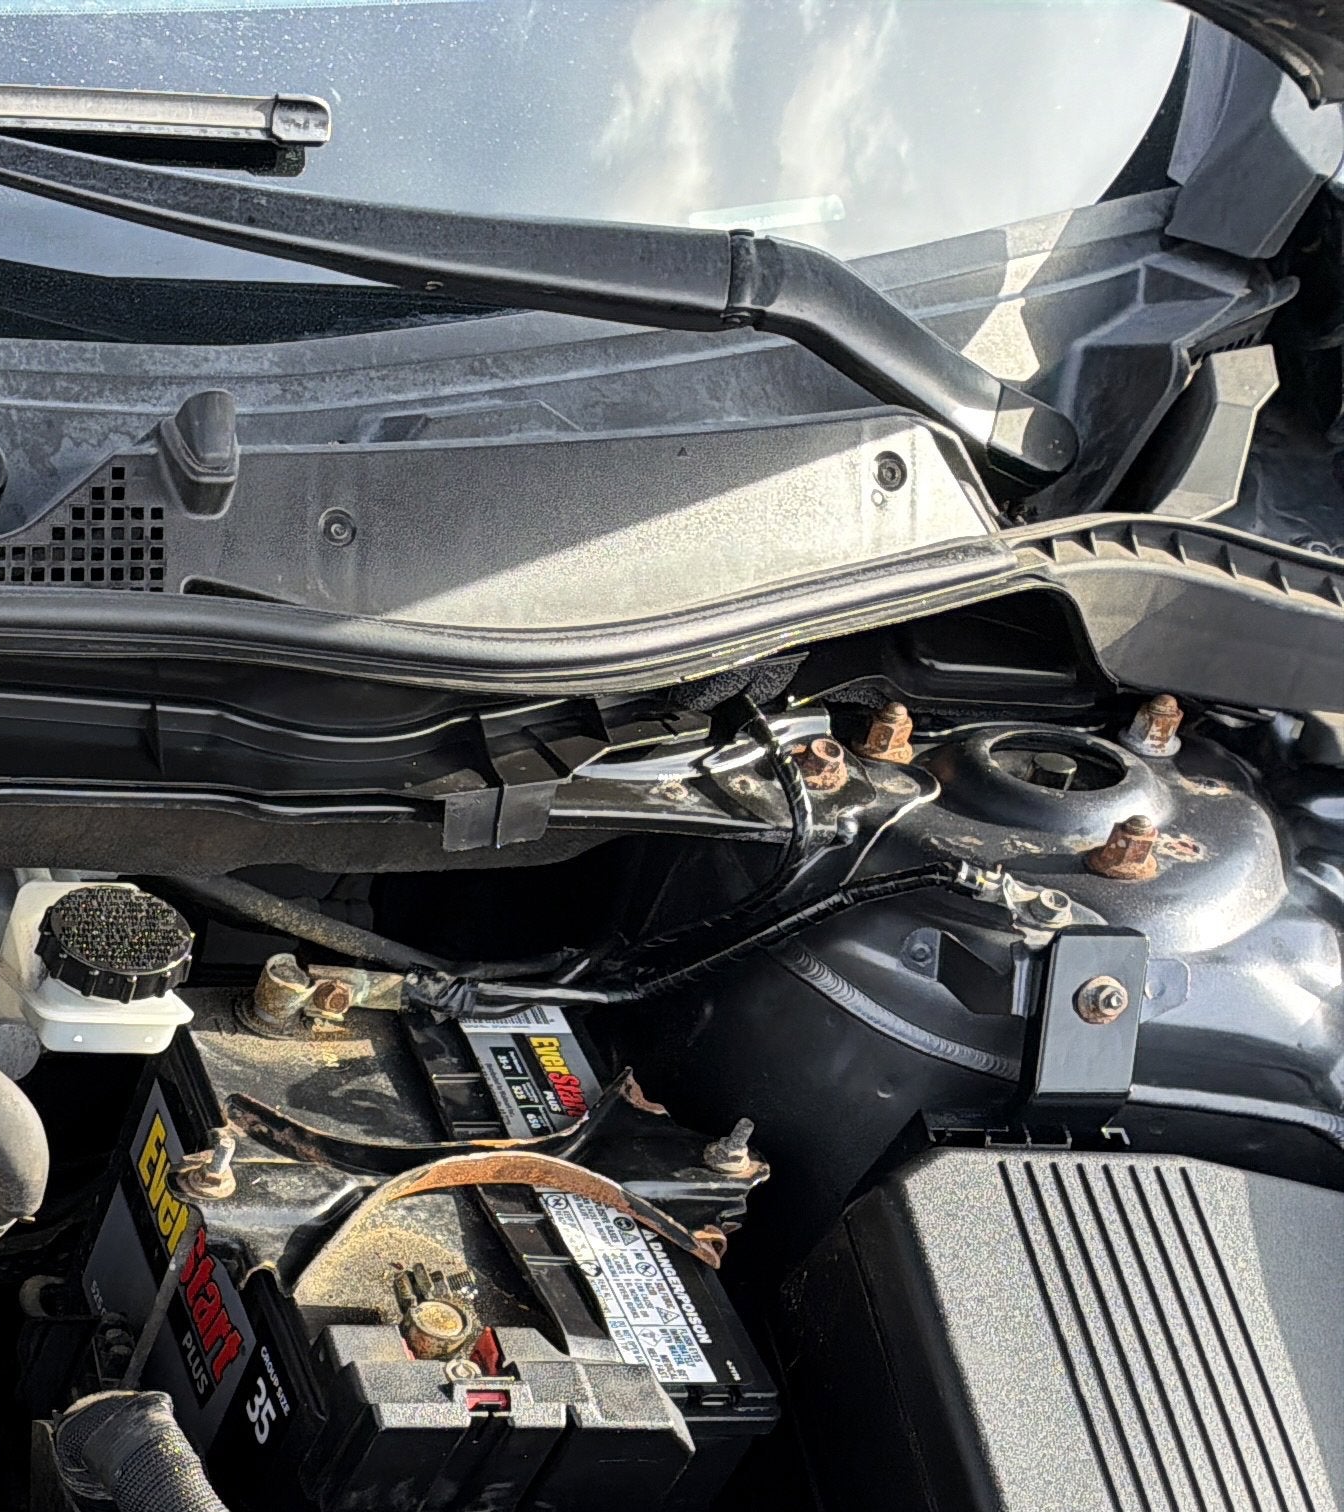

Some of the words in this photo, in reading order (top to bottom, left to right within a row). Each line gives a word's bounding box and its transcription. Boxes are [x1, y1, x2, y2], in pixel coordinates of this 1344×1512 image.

[512, 1085, 527, 1100] 525
[526, 1113, 542, 1129] 650
[543, 1090, 562, 1113] PLUS
[647, 1242, 713, 1343] DANGER/POISON
[182, 1331, 209, 1395] PLUS
[261, 1346, 281, 1387] GROUP
[276, 1386, 291, 1416] SIZE
[246, 1377, 277, 1445] 35
